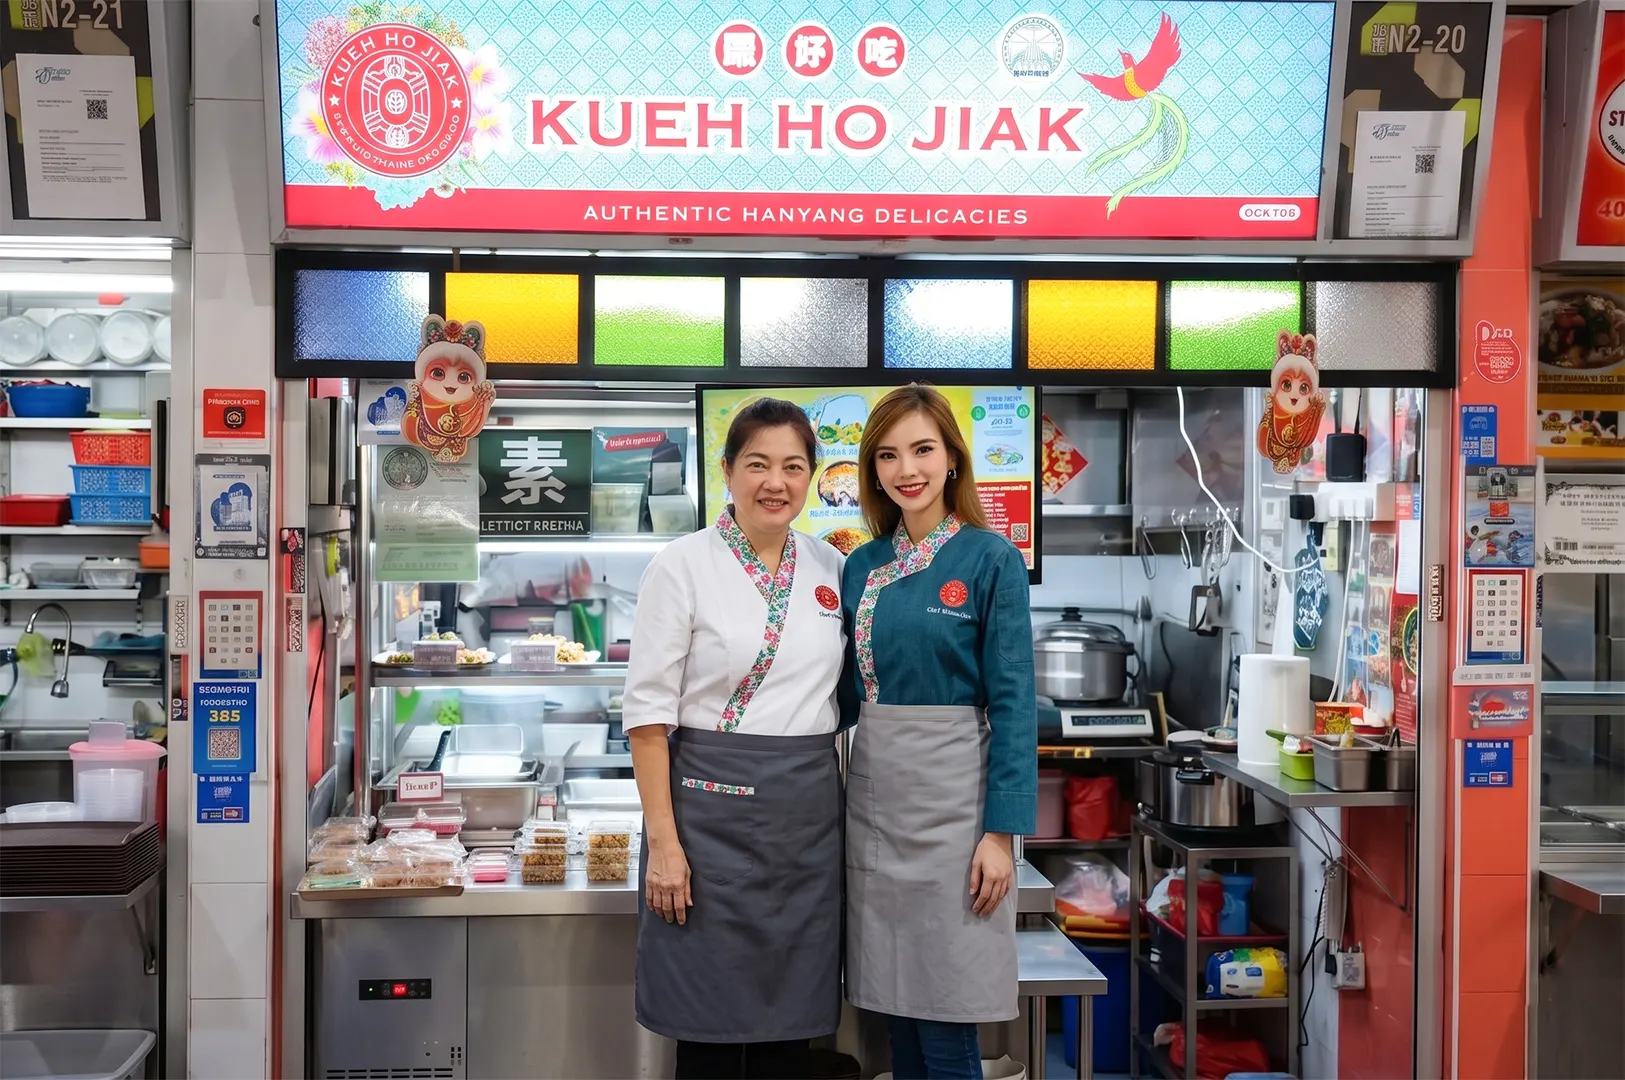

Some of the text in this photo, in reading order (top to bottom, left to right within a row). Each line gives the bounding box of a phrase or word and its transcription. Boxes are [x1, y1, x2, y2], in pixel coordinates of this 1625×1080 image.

[41, 0, 122, 29] N2-21
[1388, 24, 1466, 54] N2-20
[331, 32, 459, 89] KUEH HO JIAK
[532, 98, 1084, 152] KUEH HO JIAK
[583, 204, 1029, 225] AUTHENTIC HANYANG DELICACIES
[500, 436, 568, 506] 素
[209, 709, 241, 723] 385
